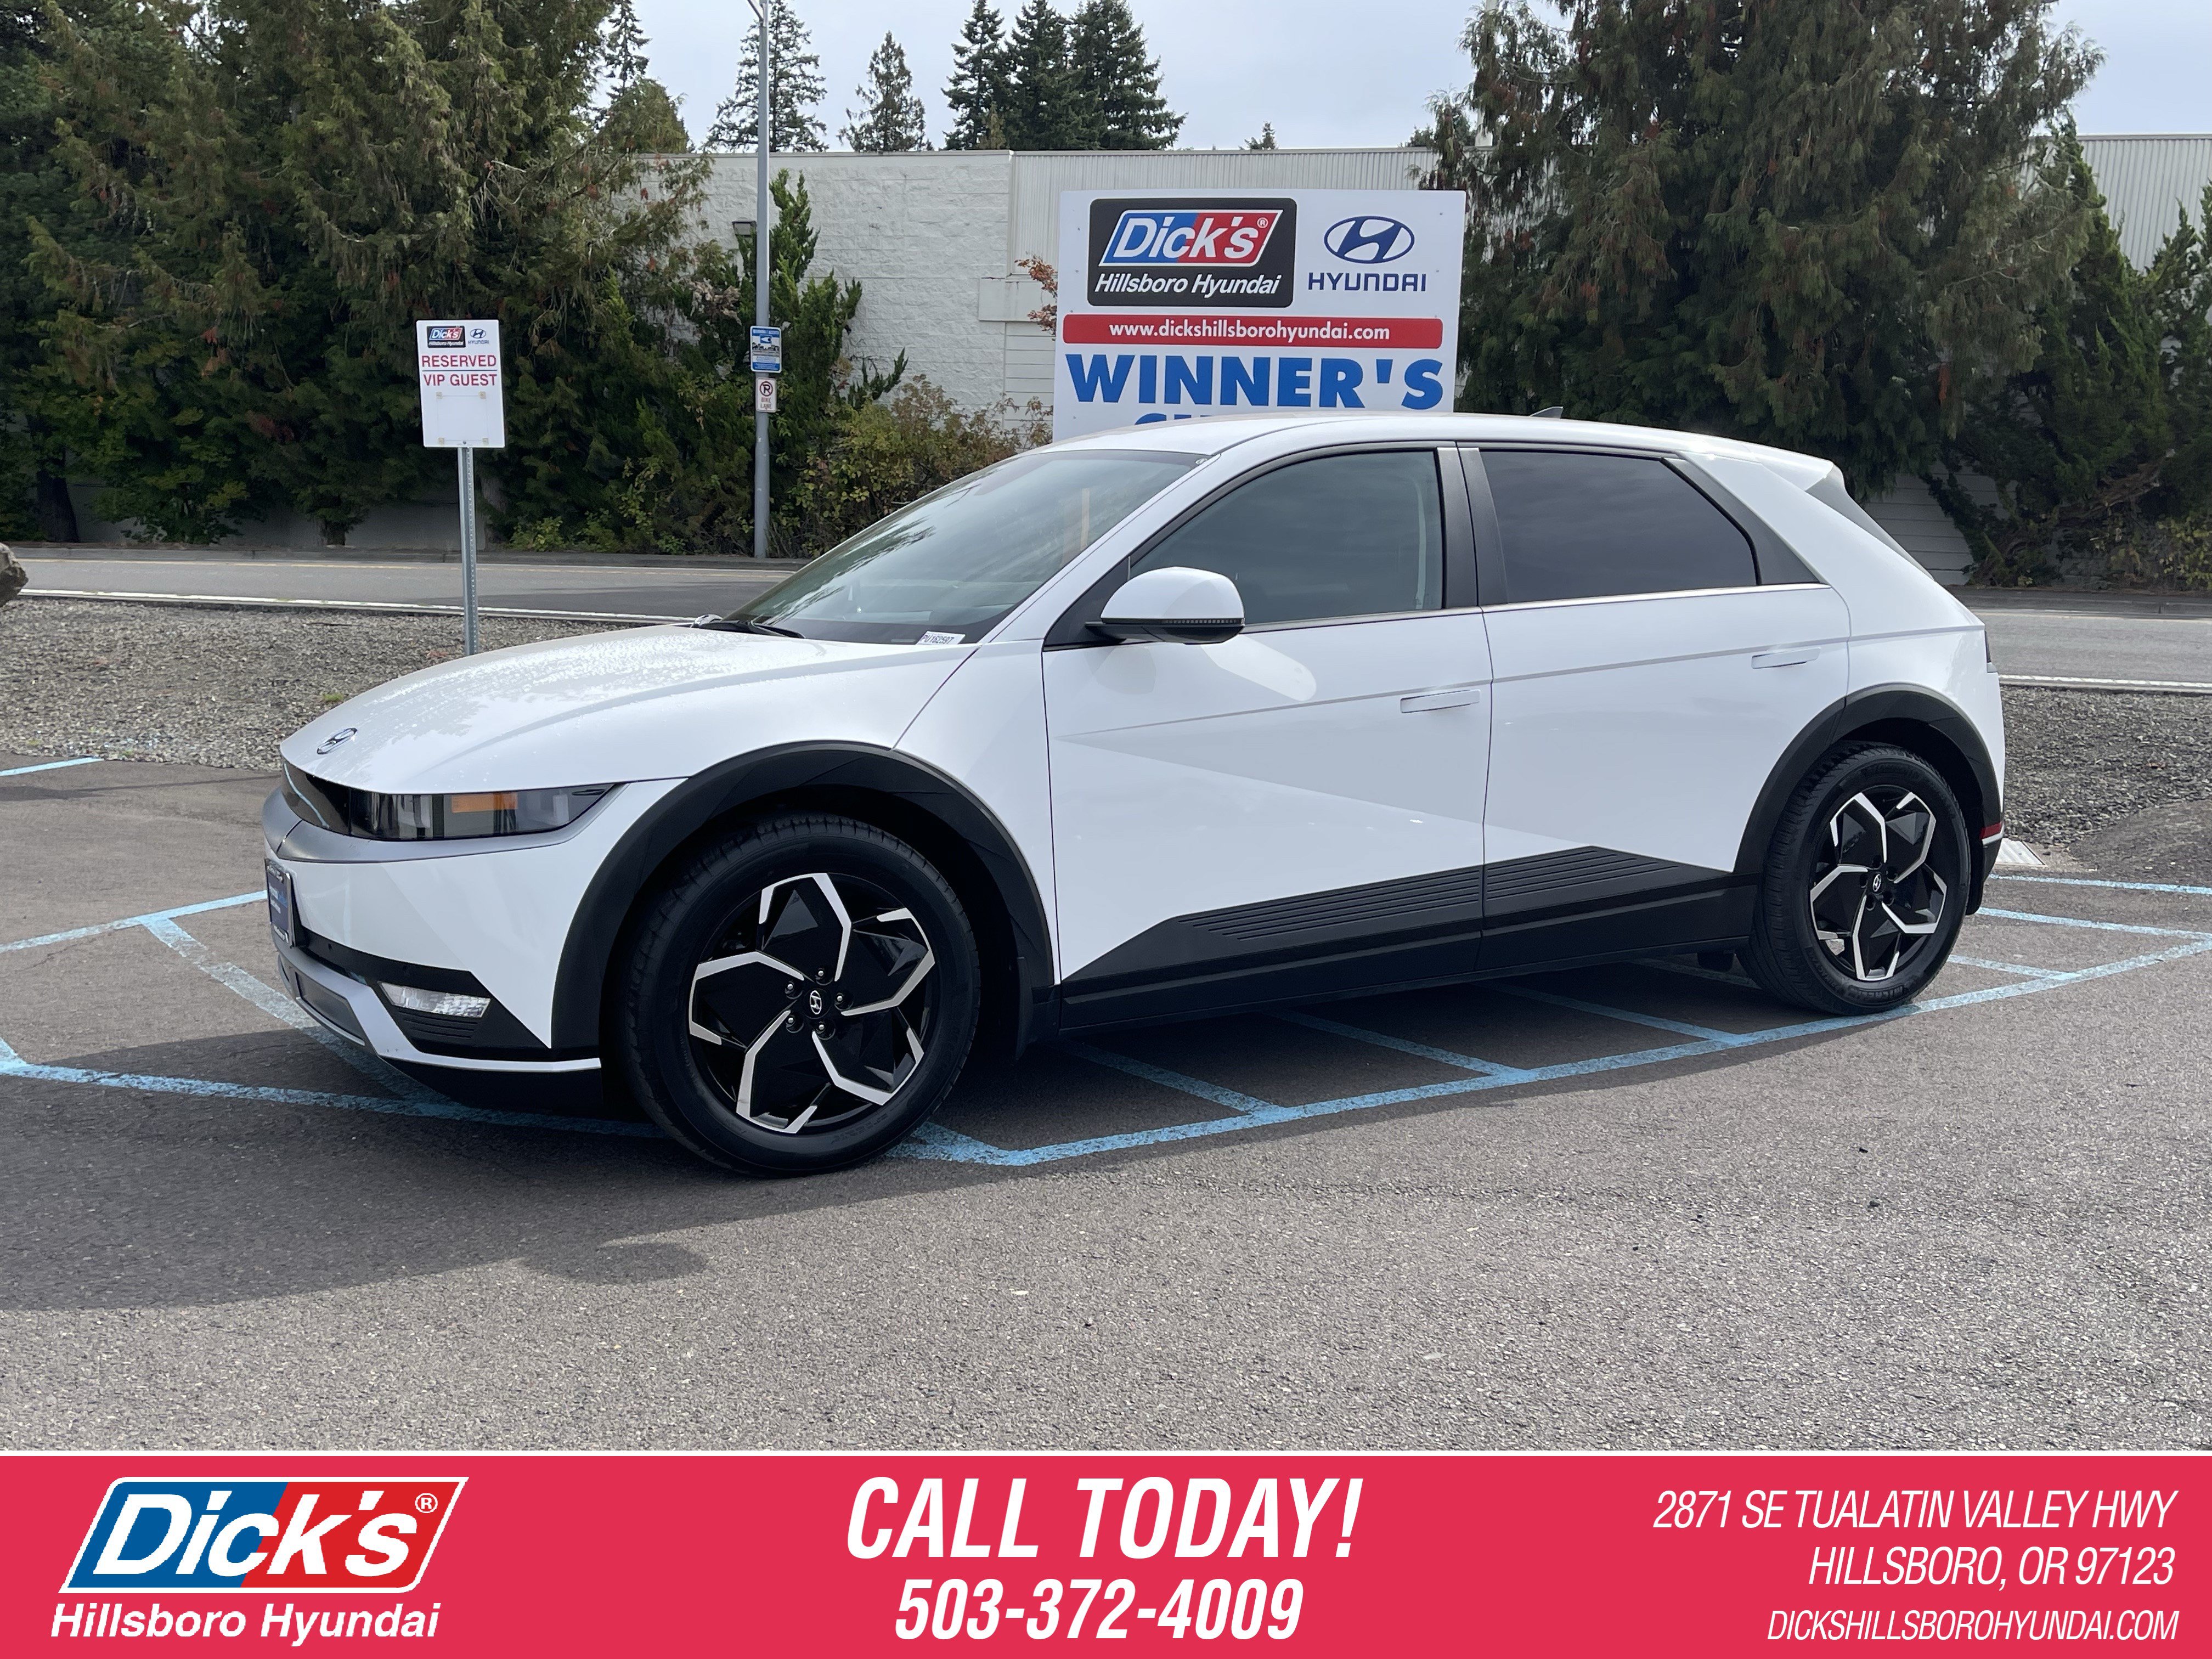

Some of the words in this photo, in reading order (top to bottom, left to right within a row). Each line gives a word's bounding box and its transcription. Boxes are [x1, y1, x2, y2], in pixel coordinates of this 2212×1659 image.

[1113, 216, 1259, 258] Dick's
[1094, 273, 1188, 292] Hillsboro
[1190, 274, 1282, 298] Hyundai
[1308, 272, 1426, 292] HYUNDAI
[1109, 320, 1390, 343] www.dickshillsborohyundai.com
[421, 355, 497, 367] RESERVED
[423, 374, 445, 386] VIP
[449, 373, 498, 386] GUEST
[1065, 354, 1443, 410] WINNER'S
